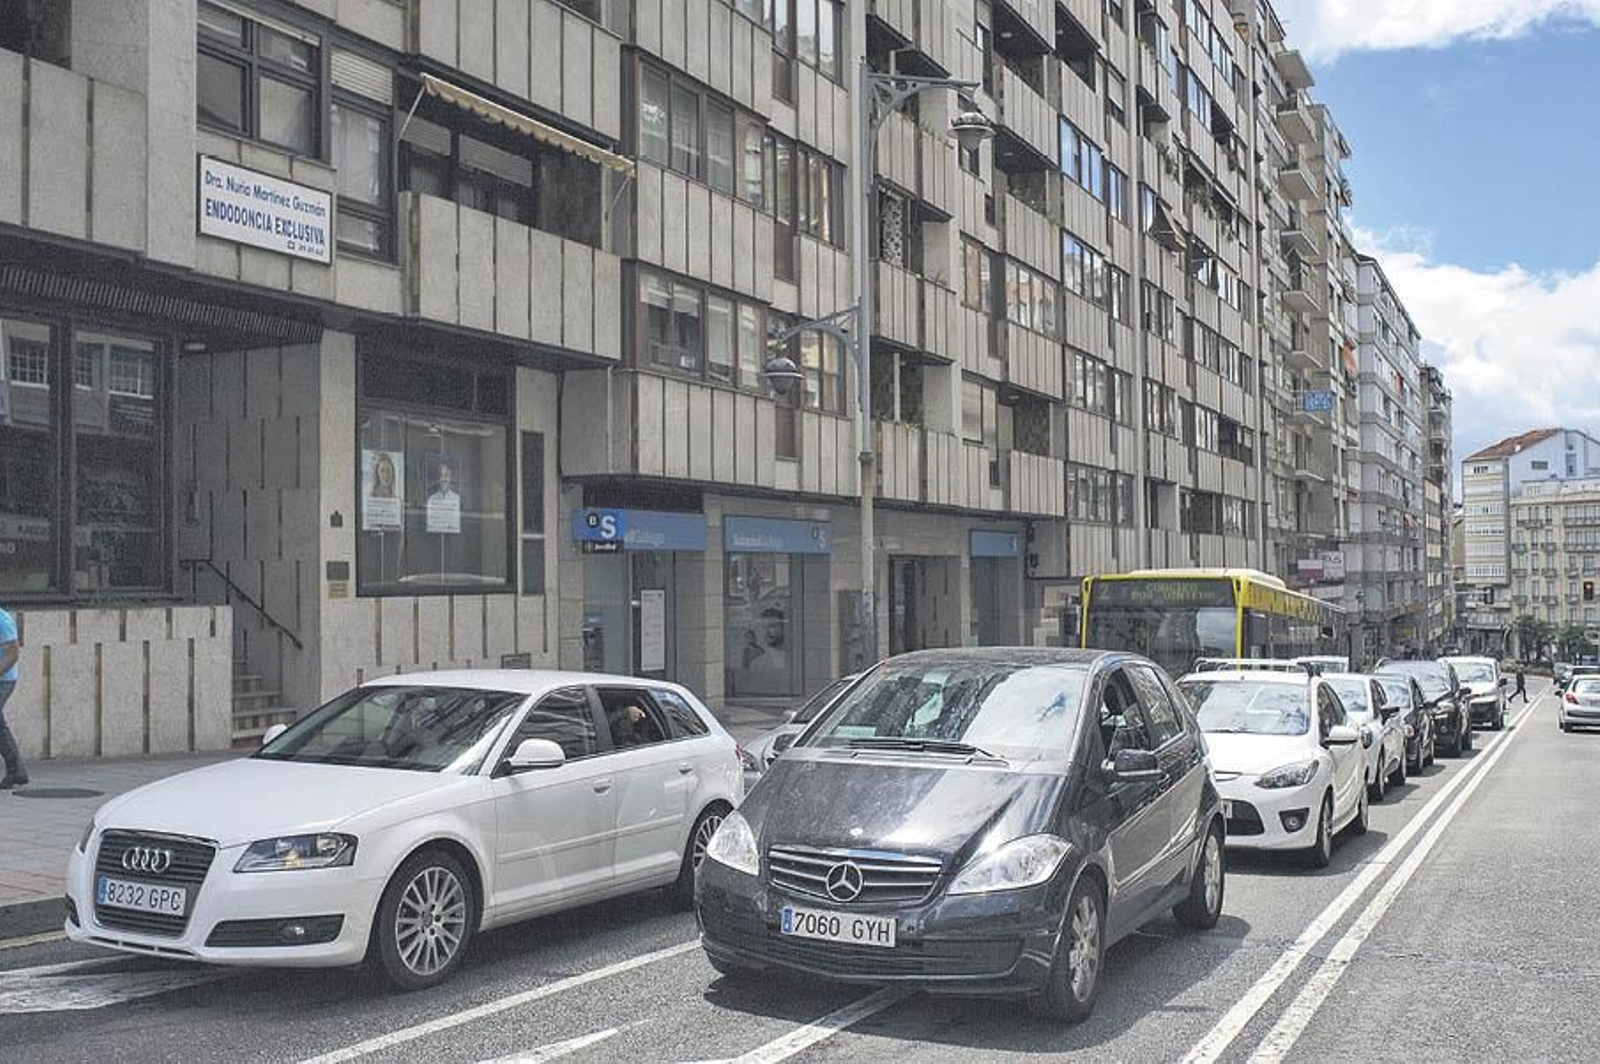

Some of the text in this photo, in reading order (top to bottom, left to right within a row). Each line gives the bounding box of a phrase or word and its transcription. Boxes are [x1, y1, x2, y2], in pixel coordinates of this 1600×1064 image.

[205, 170, 223, 188] Dra.
[293, 195, 326, 217] Guzmán
[205, 198, 326, 246] ENDODONCIA EXCLUSIVA
[108, 882, 181, 911] 8232 GPC
[794, 912, 890, 942] 7060 GYH
